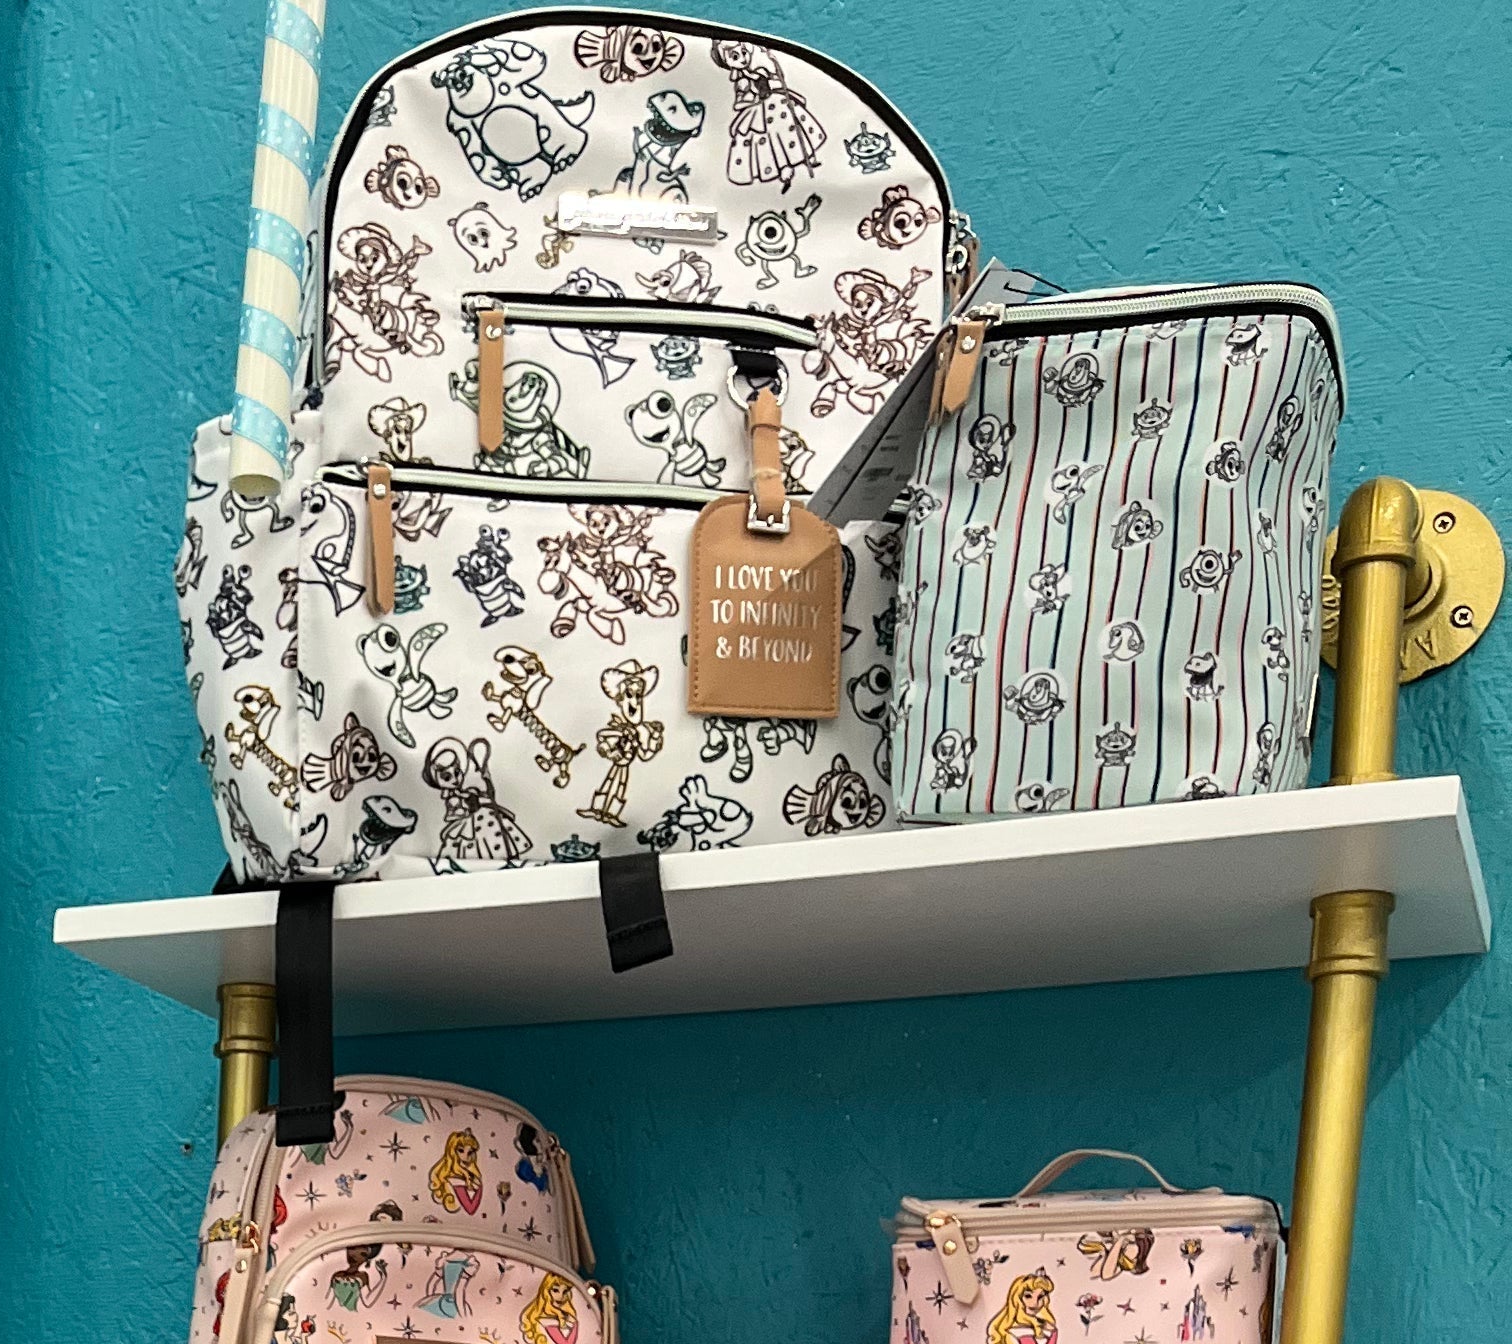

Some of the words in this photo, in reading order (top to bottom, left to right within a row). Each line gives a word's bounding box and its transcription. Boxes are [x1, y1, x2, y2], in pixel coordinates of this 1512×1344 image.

[715, 564, 722, 589] I
[727, 564, 775, 592] LOVE
[779, 567, 818, 593] YOU
[709, 599, 734, 624] TO
[740, 600, 822, 631] INFINITY
[716, 635, 733, 659] &
[738, 634, 813, 663] BEYOND
